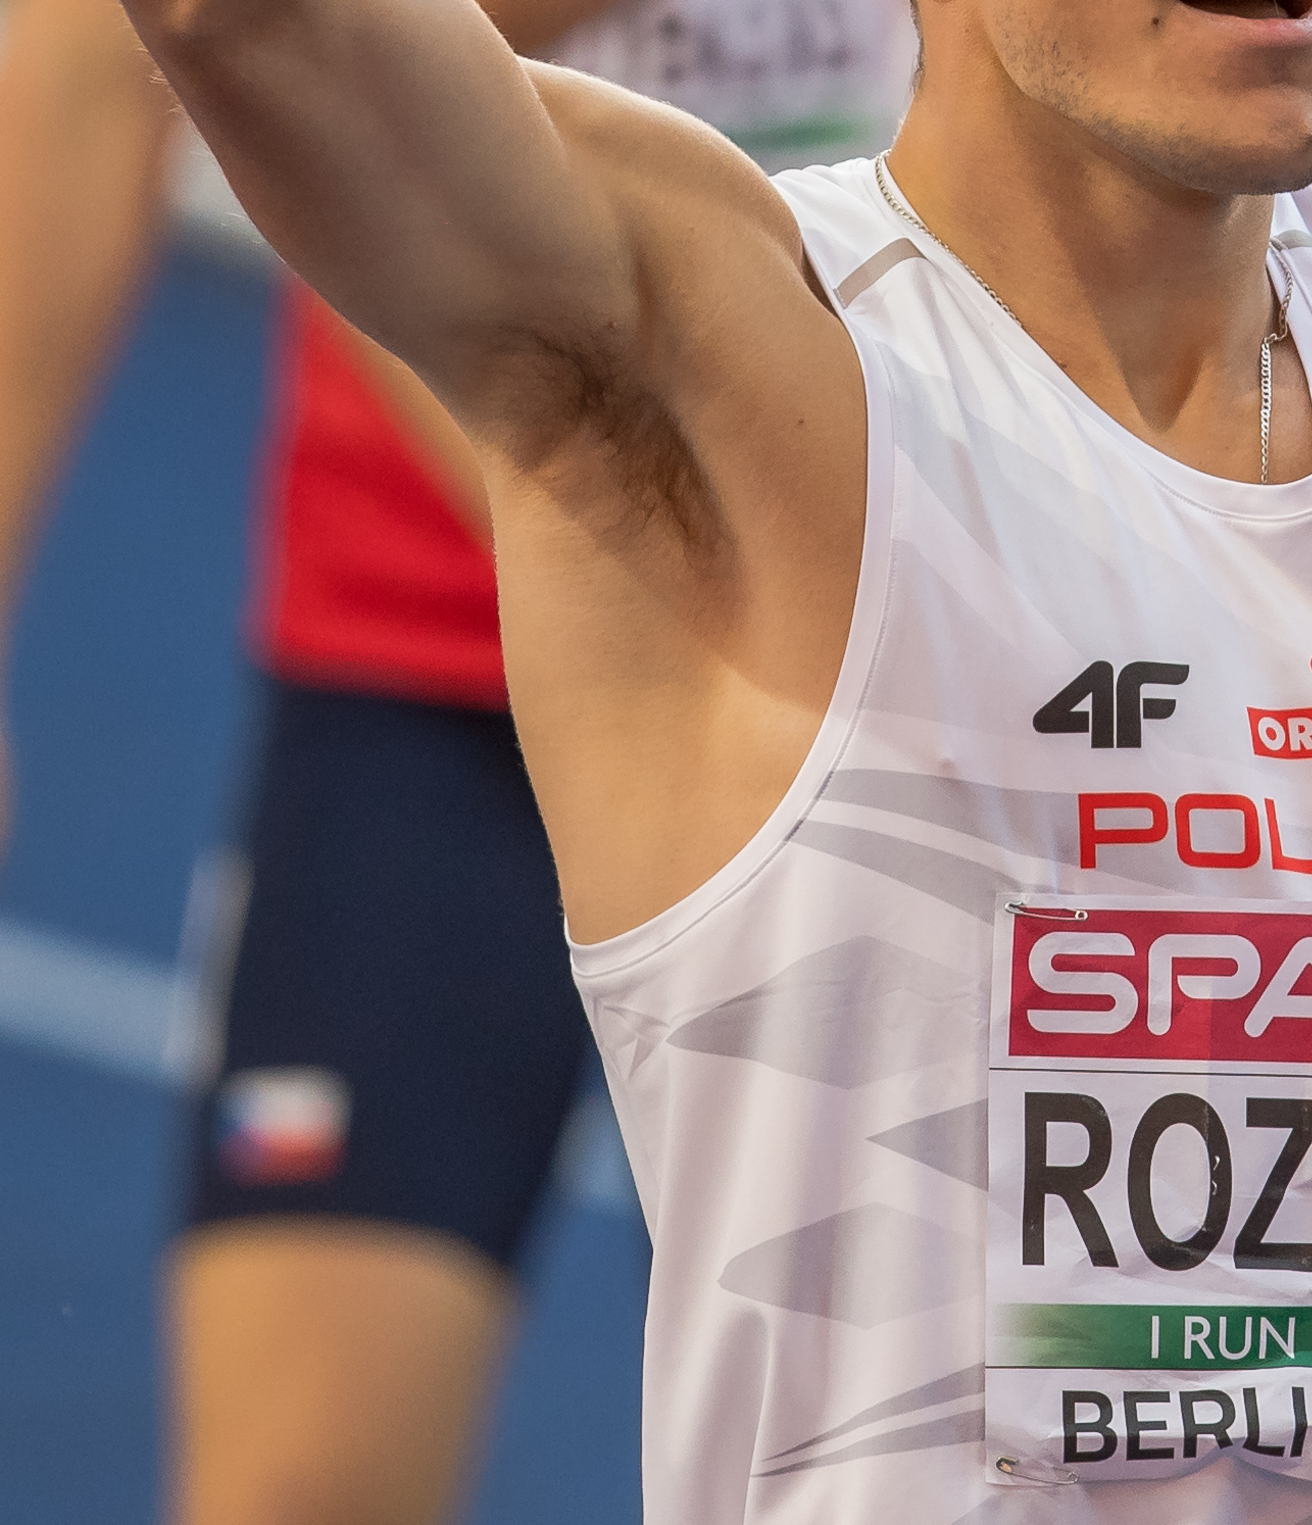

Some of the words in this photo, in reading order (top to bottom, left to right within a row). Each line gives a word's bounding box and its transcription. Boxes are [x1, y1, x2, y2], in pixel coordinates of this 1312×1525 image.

[1033, 660, 1190, 749] 4F
[1150, 1315, 1160, 1359] I
[1184, 1315, 1296, 1360] RUN
